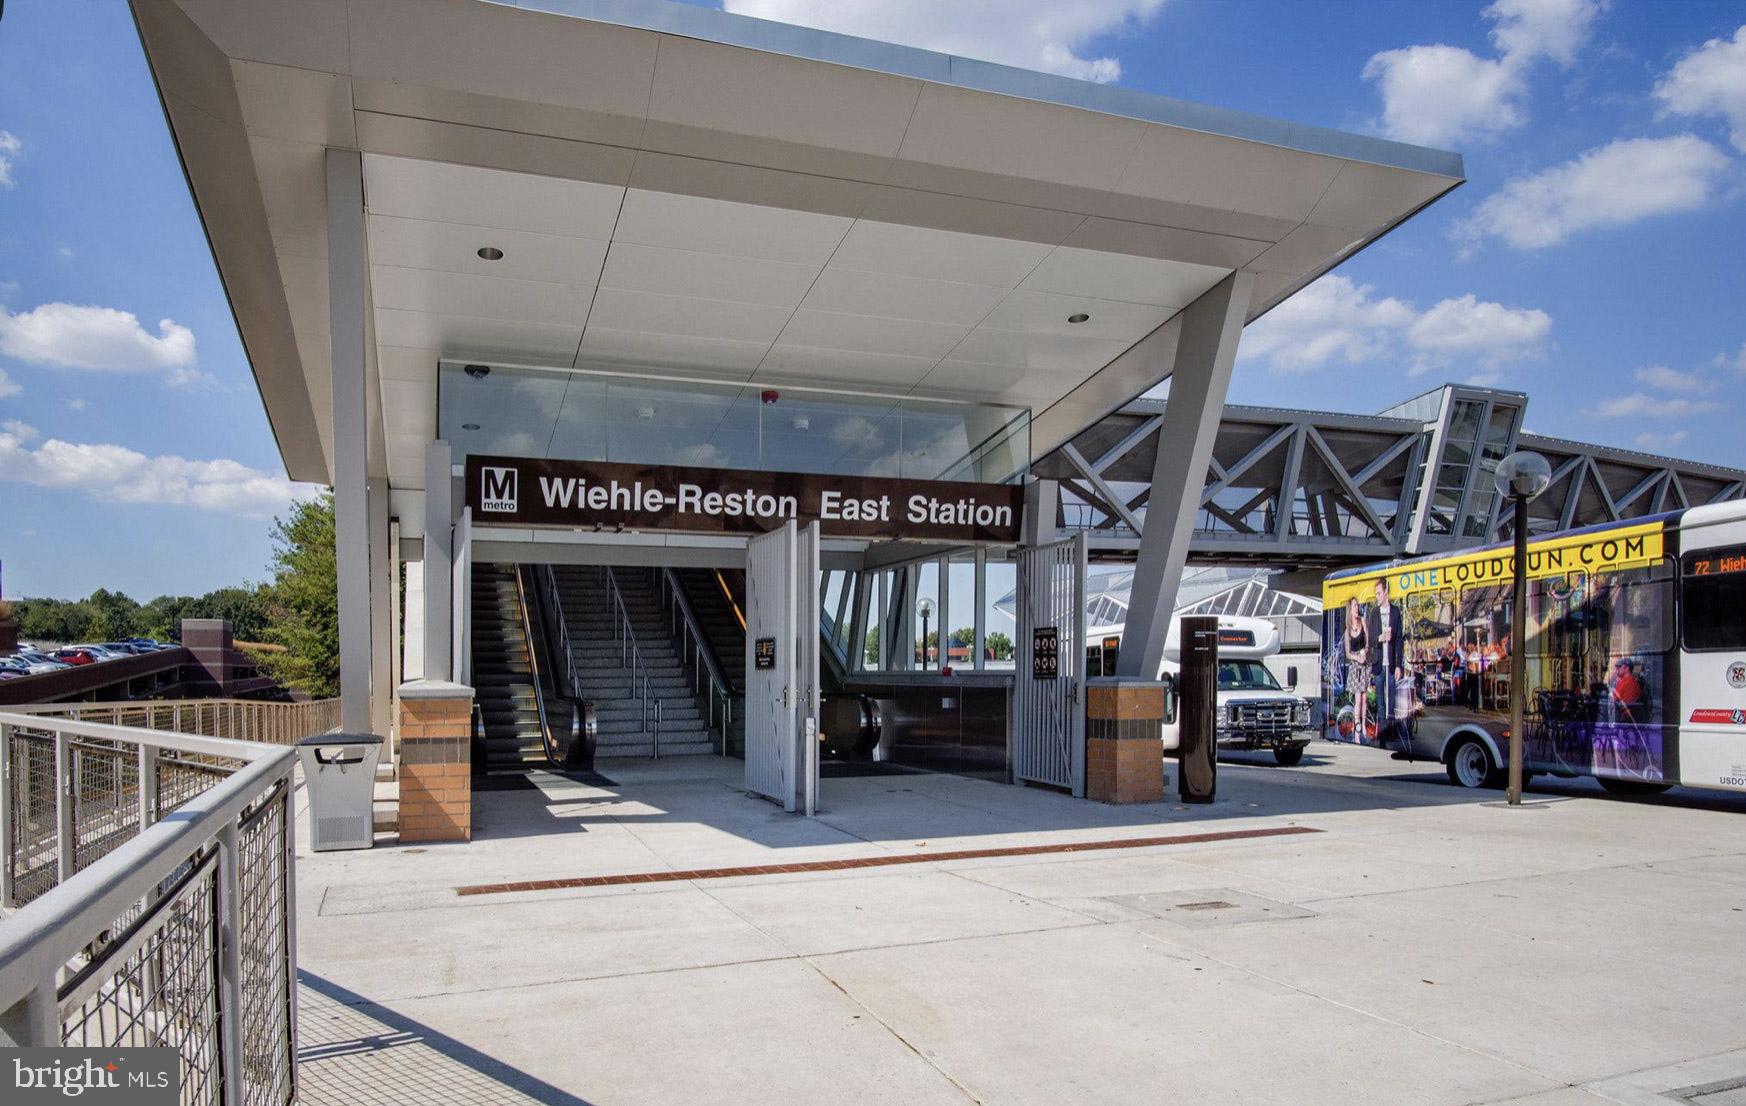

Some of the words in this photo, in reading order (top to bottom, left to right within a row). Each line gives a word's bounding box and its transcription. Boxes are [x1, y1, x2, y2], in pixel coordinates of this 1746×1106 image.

[484, 469, 516, 500] M
[483, 501, 515, 511] metro
[539, 477, 797, 518] Wiehle-Reston
[820, 490, 890, 522] East
[907, 494, 1012, 527] Station
